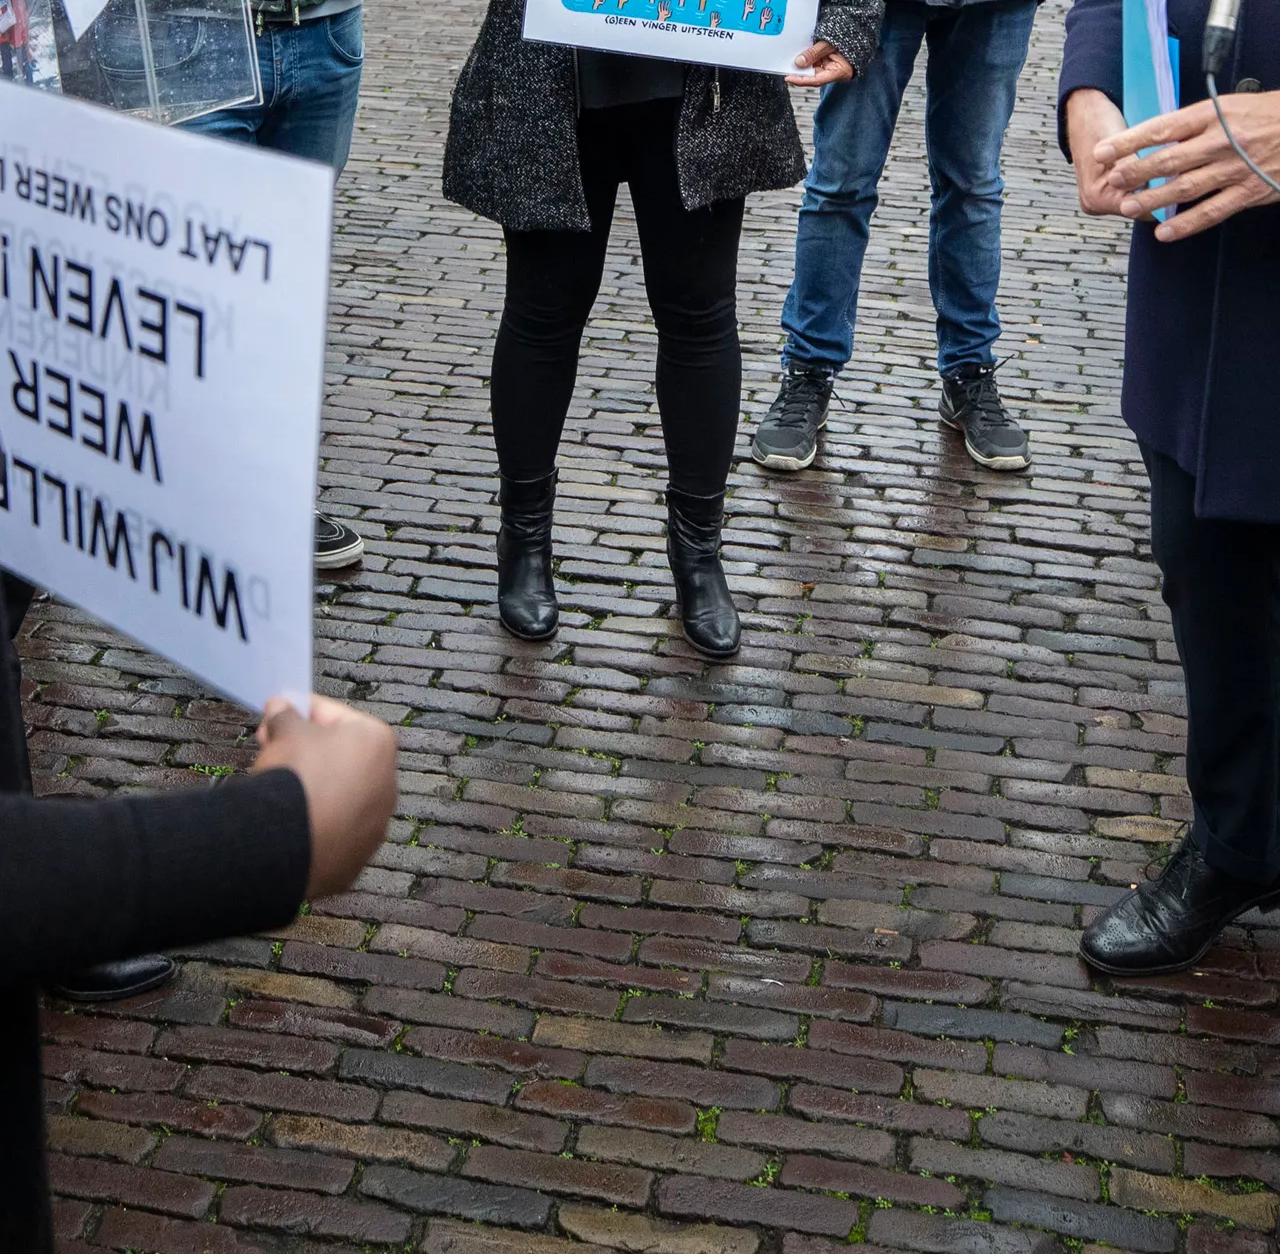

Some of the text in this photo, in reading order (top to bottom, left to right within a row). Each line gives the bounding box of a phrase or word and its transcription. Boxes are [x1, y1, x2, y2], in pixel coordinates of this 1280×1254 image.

[604, 15, 637, 27] (G)EEN
[681, 27, 735, 41] UITSTEKEN
[14, 160, 97, 225] WEER
[105, 192, 169, 248] ONS
[180, 219, 271, 283] LAAT
[30, 245, 205, 379] LEVEN
[7, 349, 163, 486] WEER
[150, 527, 248, 644] WIJ
